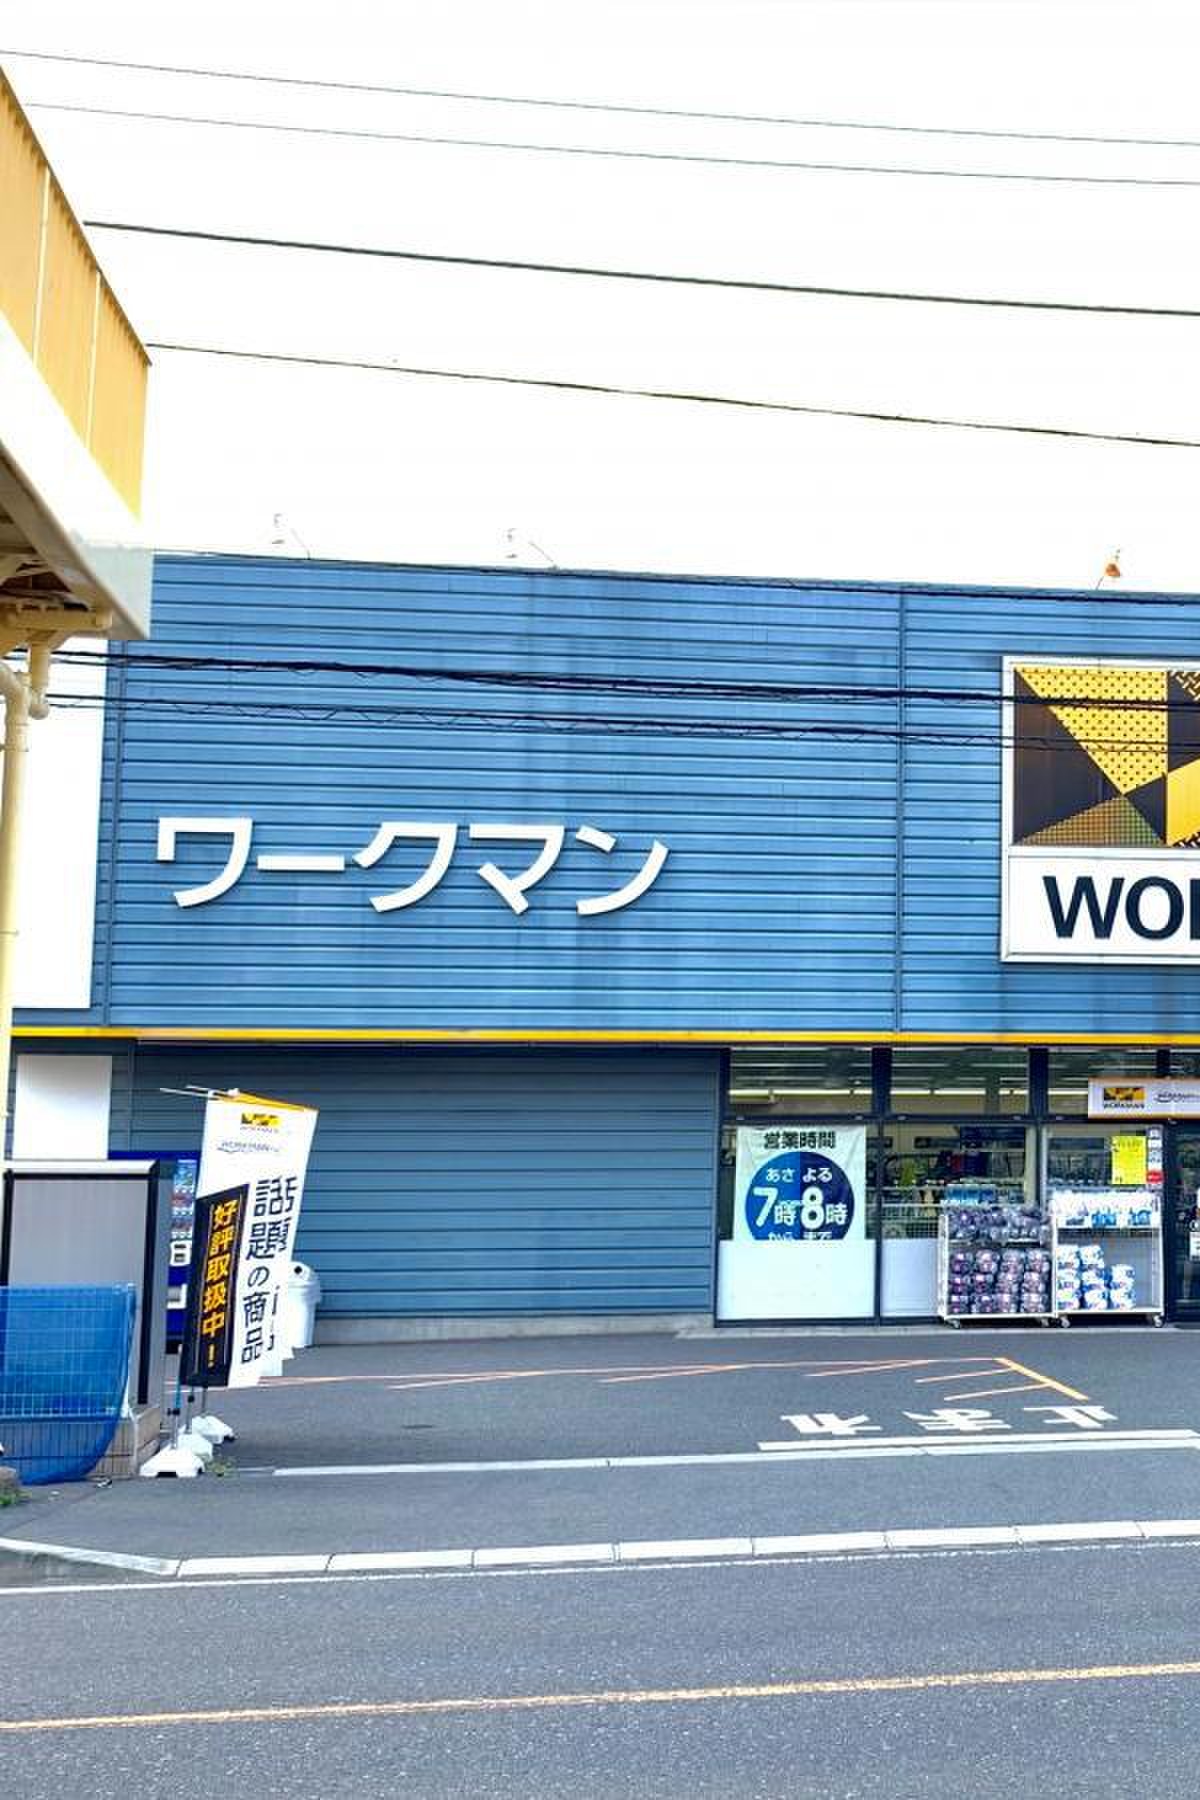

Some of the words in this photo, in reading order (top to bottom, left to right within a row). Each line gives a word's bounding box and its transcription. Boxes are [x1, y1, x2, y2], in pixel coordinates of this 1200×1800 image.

[156, 817, 669, 915] ワークマン
[764, 1131, 835, 1149] 営業時間
[766, 1168, 795, 1182] あさ
[802, 1168, 833, 1183] よる
[753, 1187, 797, 1227] 7時
[800, 1186, 848, 1230] 8時
[241, 1176, 284, 1364] 話題の商品
[780, 1405, 1119, 1436] 止まれ
